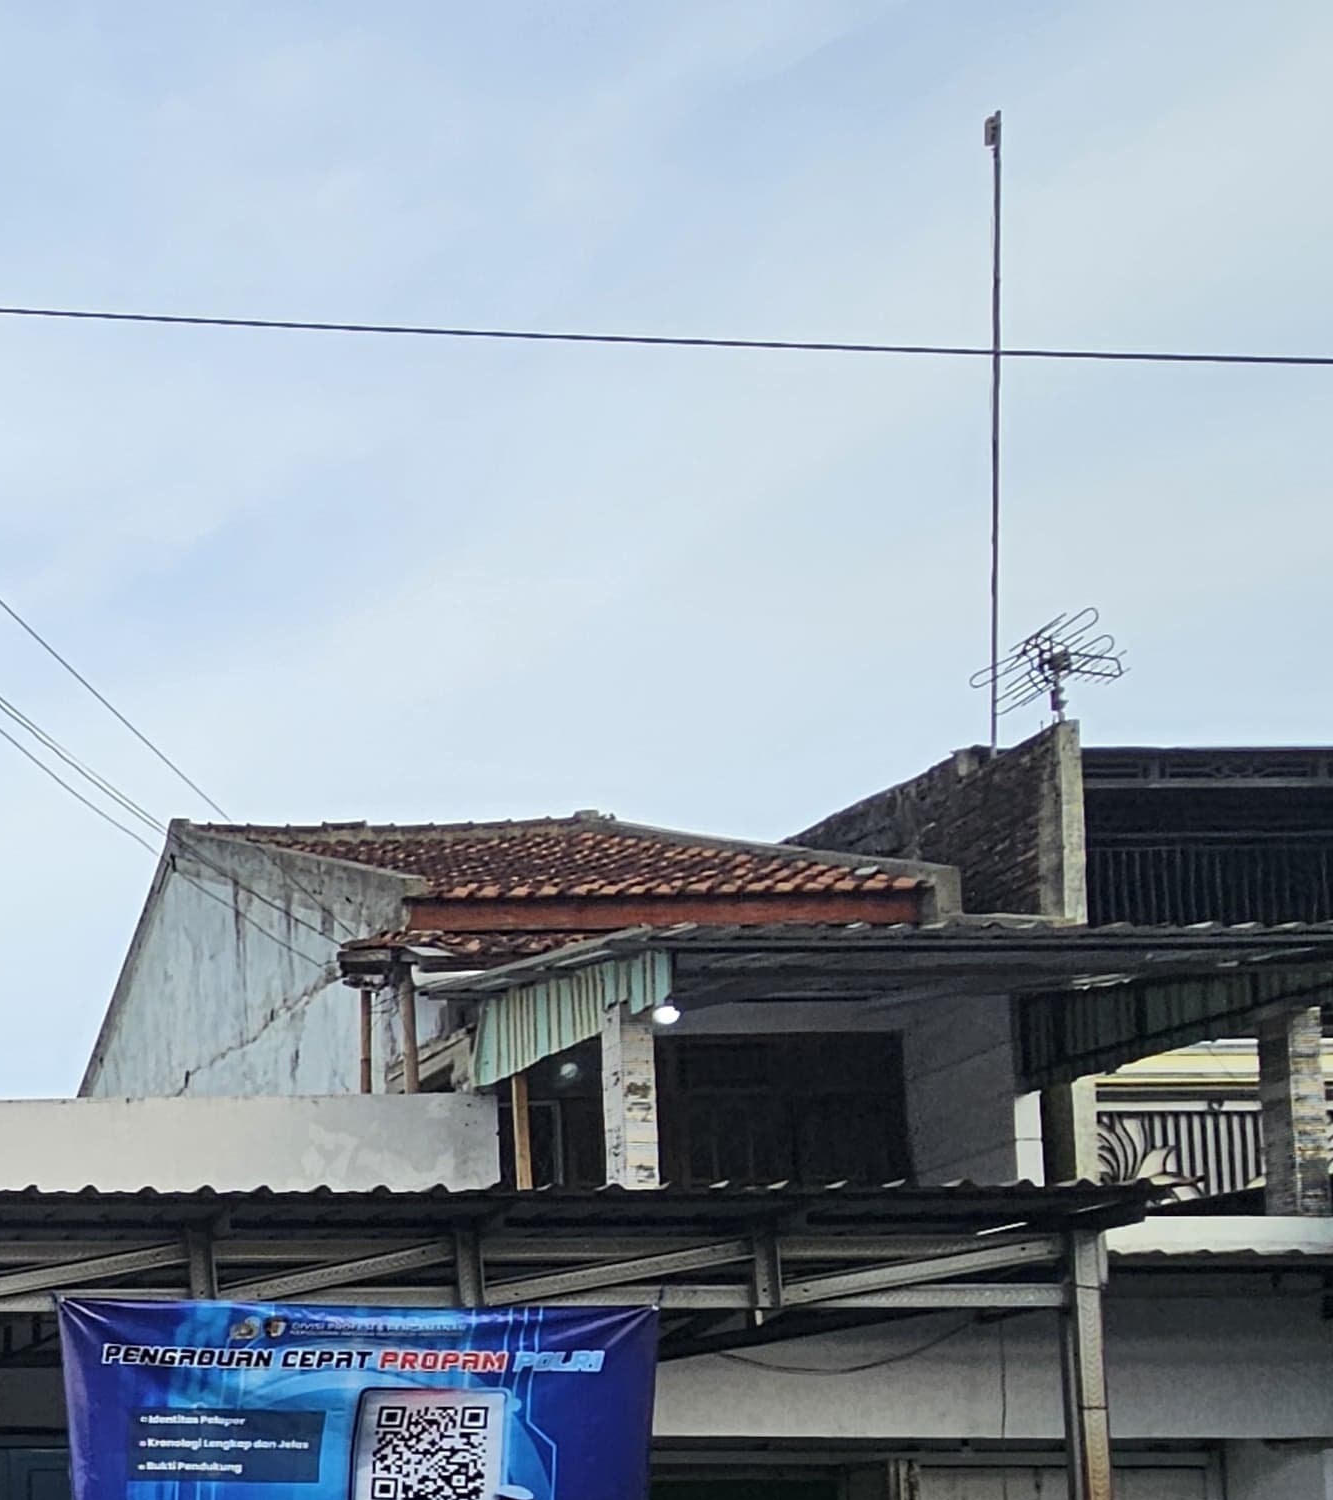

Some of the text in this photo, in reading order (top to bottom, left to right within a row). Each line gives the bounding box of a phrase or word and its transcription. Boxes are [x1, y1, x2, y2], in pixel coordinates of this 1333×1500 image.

[102, 1344, 273, 1369] PENGADUAN
[281, 1349, 373, 1370] CEPAT
[379, 1350, 508, 1374] PROPAM
